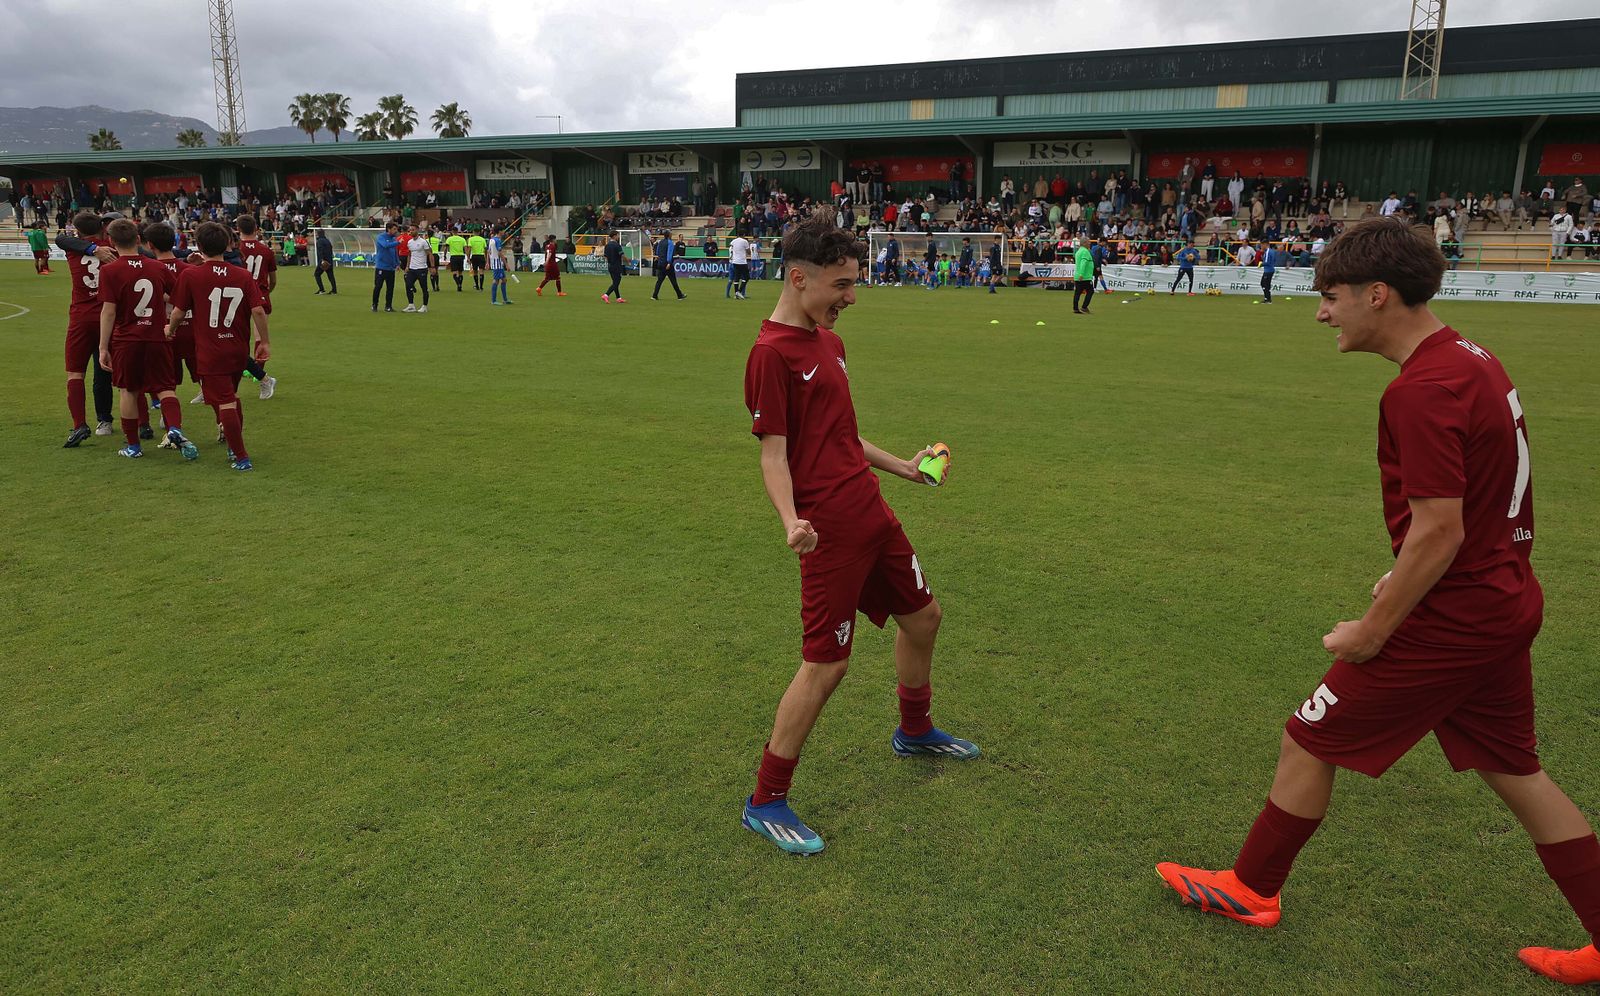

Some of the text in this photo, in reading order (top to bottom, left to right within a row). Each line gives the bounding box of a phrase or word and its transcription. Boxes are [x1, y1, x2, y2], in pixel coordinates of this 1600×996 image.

[639, 152, 686, 169] RSG
[1028, 141, 1093, 160] RSG
[490, 161, 531, 174] RSG
[81, 255, 100, 289] 3
[246, 255, 263, 280] 11
[674, 262, 729, 273] COPA ANDAL
[133, 278, 154, 318] 2
[1108, 280, 1127, 288] RFAF
[1475, 289, 1500, 298] RFAF
[1514, 290, 1540, 299] RFAF
[1554, 291, 1580, 300] RFAF
[208, 286, 244, 328] 17
[1301, 683, 1339, 722] 5
